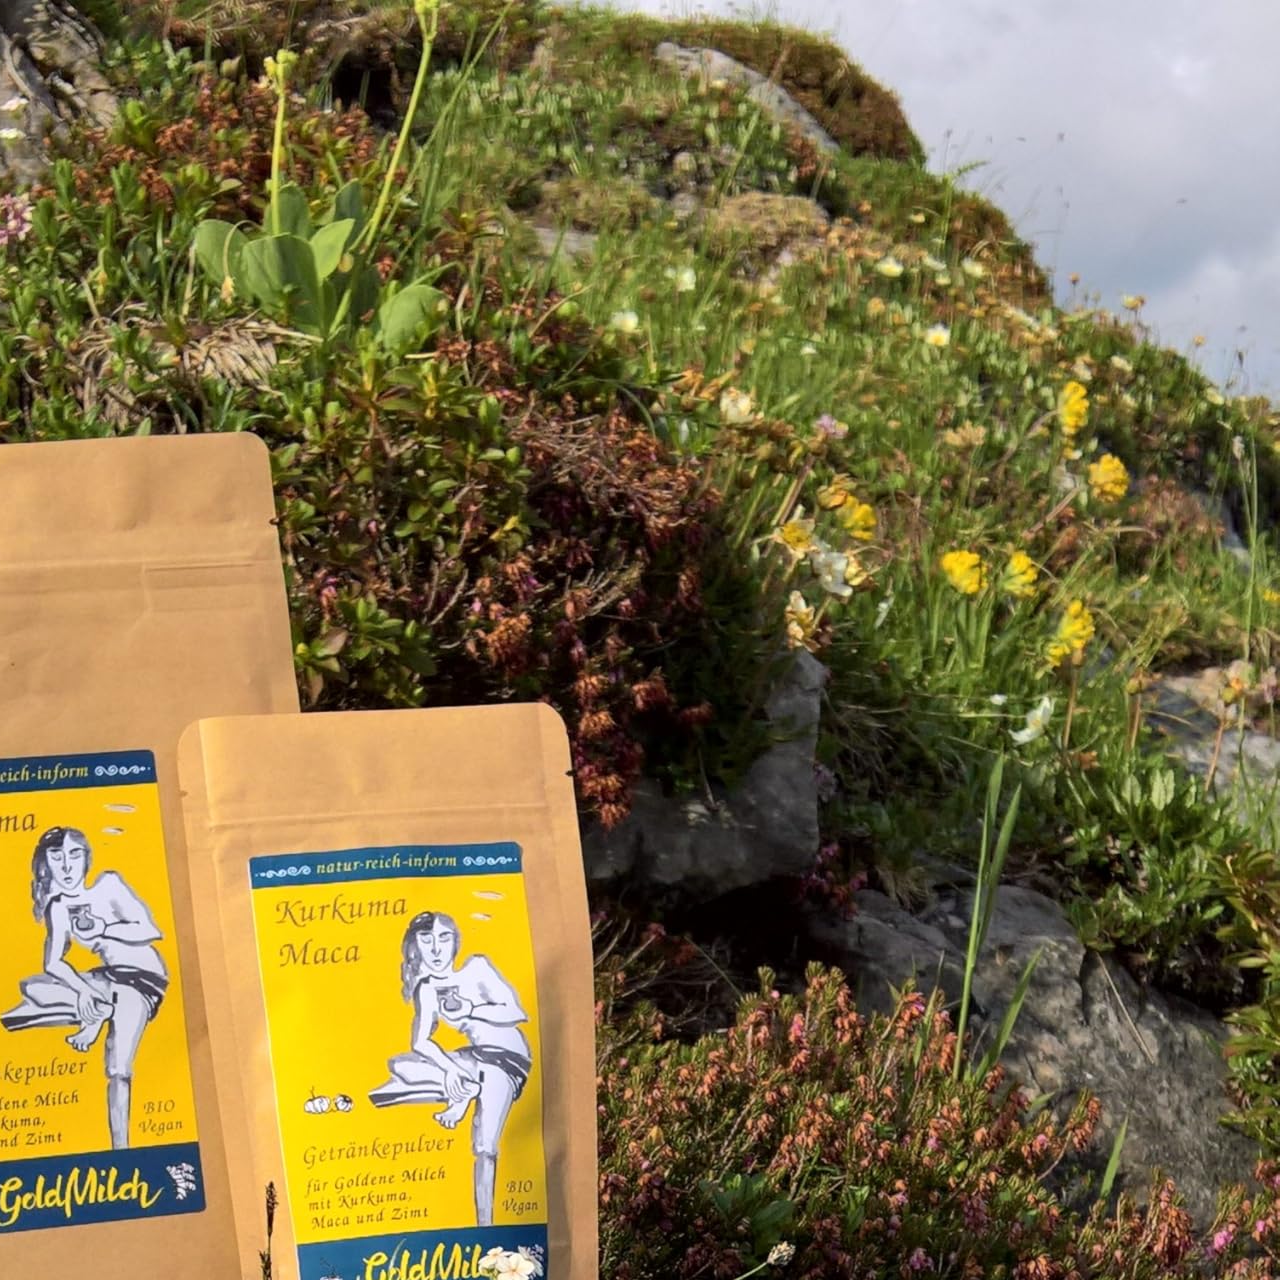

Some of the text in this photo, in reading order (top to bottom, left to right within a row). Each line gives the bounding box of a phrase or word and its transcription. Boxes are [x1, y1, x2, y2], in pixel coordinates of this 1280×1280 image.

[276, 893, 407, 927] Kurkuma
[279, 939, 360, 967] Maca
[35, 1089, 79, 1107] Milch
[143, 1099, 175, 1114] BIO
[138, 1119, 183, 1136] Vegan
[25, 1132, 62, 1146] Zimt
[303, 1134, 455, 1169] Getränkepulver
[305, 1166, 446, 1197] für Goldene Milch
[506, 1180, 533, 1193] BIO
[309, 1197, 331, 1212] mit
[503, 1199, 539, 1216] Vegan
[311, 1207, 429, 1230] Maca und Zimt
